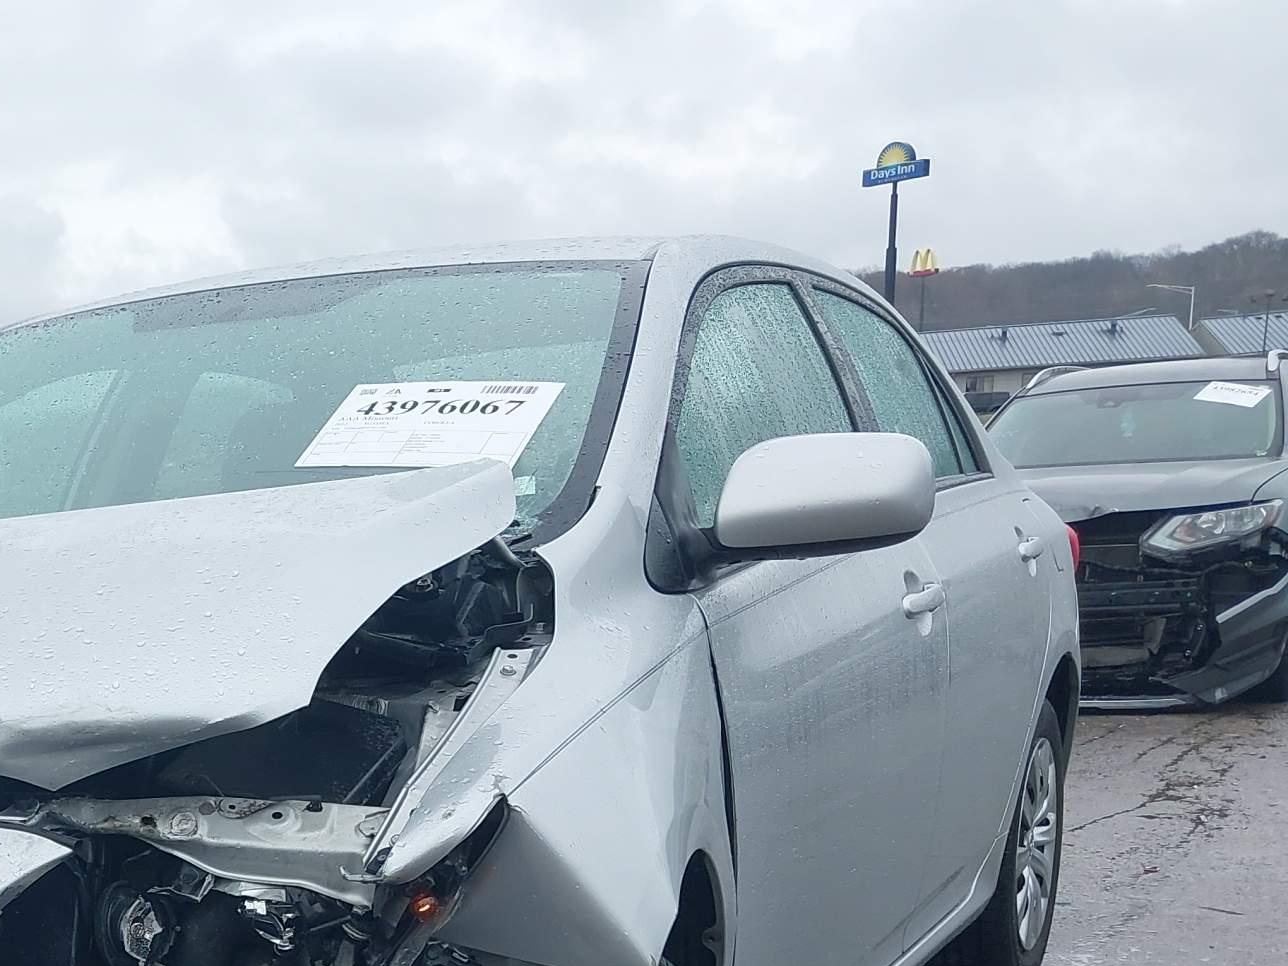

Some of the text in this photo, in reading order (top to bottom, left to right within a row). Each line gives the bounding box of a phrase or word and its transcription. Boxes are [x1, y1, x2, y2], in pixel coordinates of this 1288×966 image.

[870, 167, 896, 180] Days
[897, 164, 915, 175] Inn
[355, 399, 528, 416] 43976067
